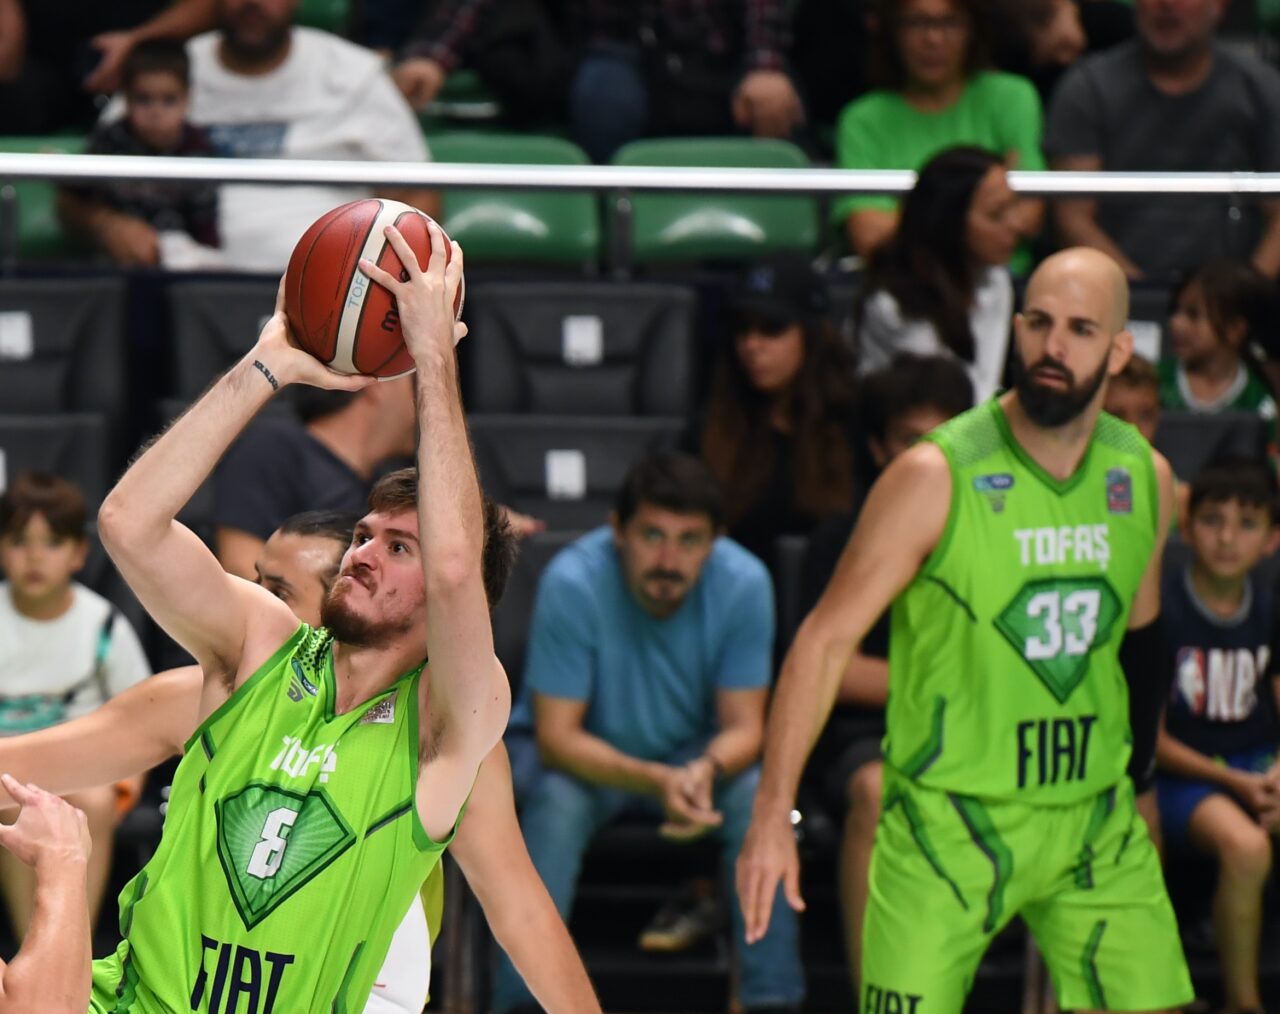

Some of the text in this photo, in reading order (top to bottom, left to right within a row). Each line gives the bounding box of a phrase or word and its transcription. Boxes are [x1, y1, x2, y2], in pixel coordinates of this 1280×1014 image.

[1014, 524, 1110, 571] TOFAŞ
[1024, 589, 1100, 660] 33
[1017, 714, 1098, 789] FIAT
